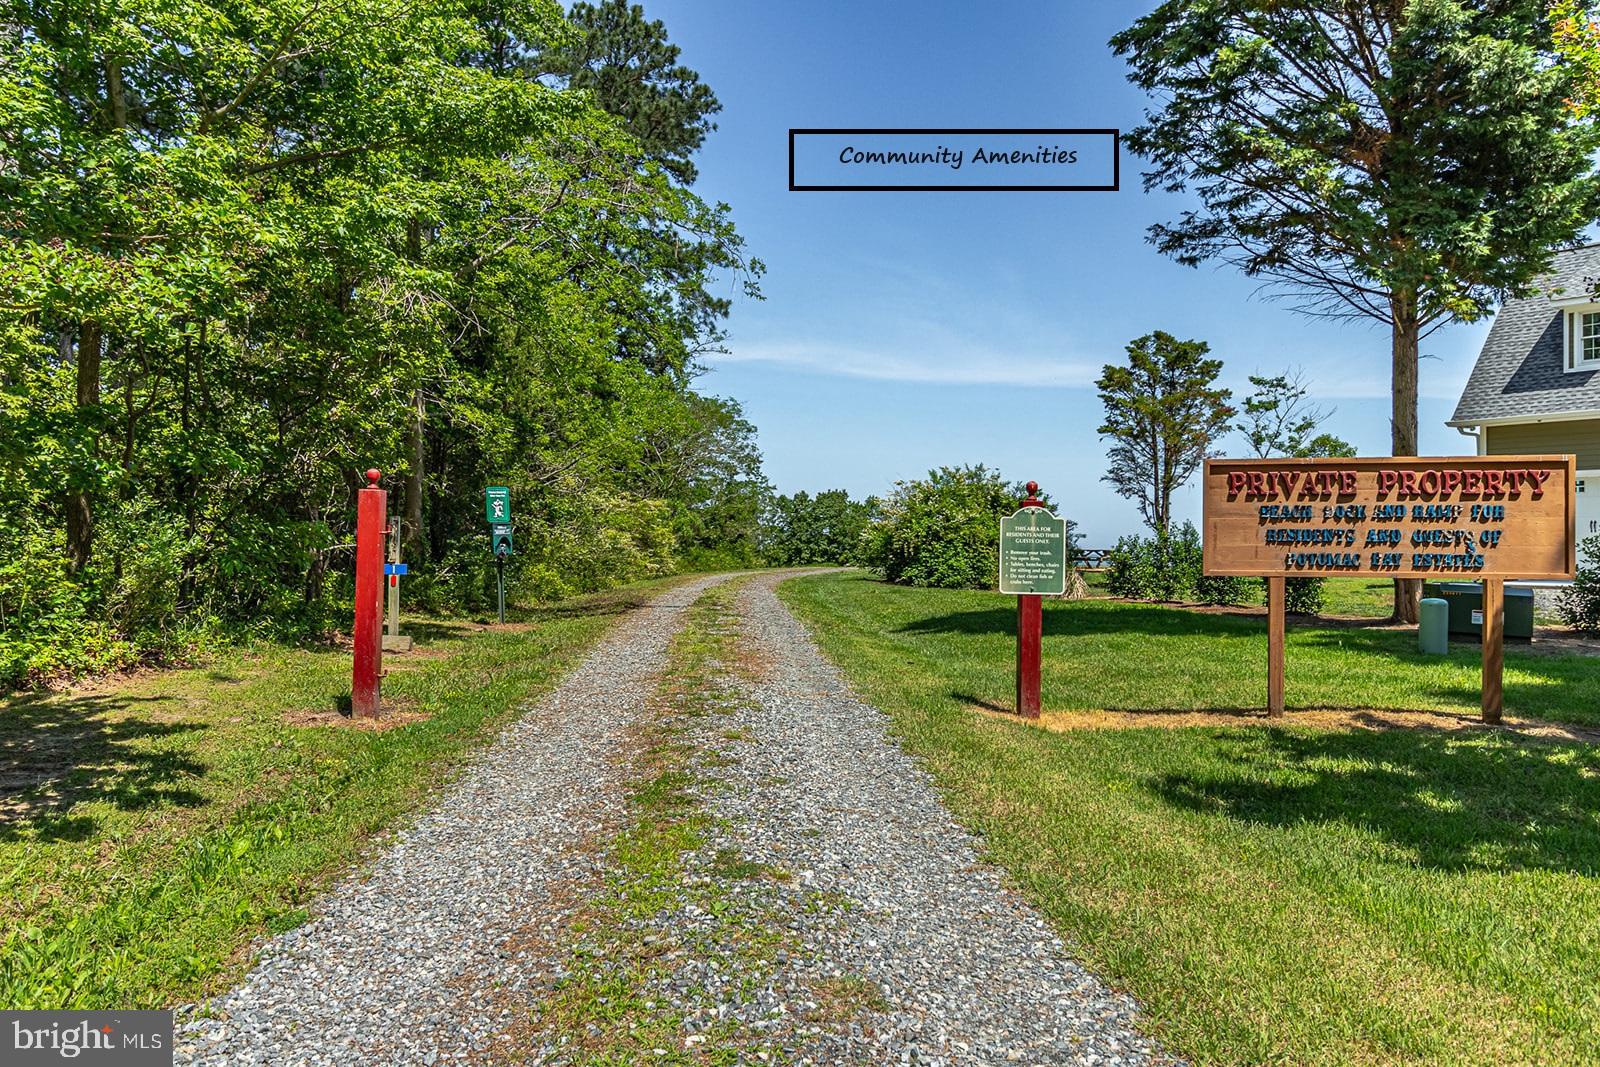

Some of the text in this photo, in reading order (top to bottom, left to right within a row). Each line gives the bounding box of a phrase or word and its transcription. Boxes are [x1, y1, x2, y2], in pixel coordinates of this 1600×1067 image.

[1227, 469, 1551, 498] PRIVATE PROPERTY
[1258, 505, 1312, 520] BEACH
[1373, 505, 1407, 520] AND
[1471, 505, 1505, 519] FOR
[1265, 529, 1356, 544] RESIDENTS
[1366, 529, 1402, 544] AND
[1480, 530, 1503, 544] OF
